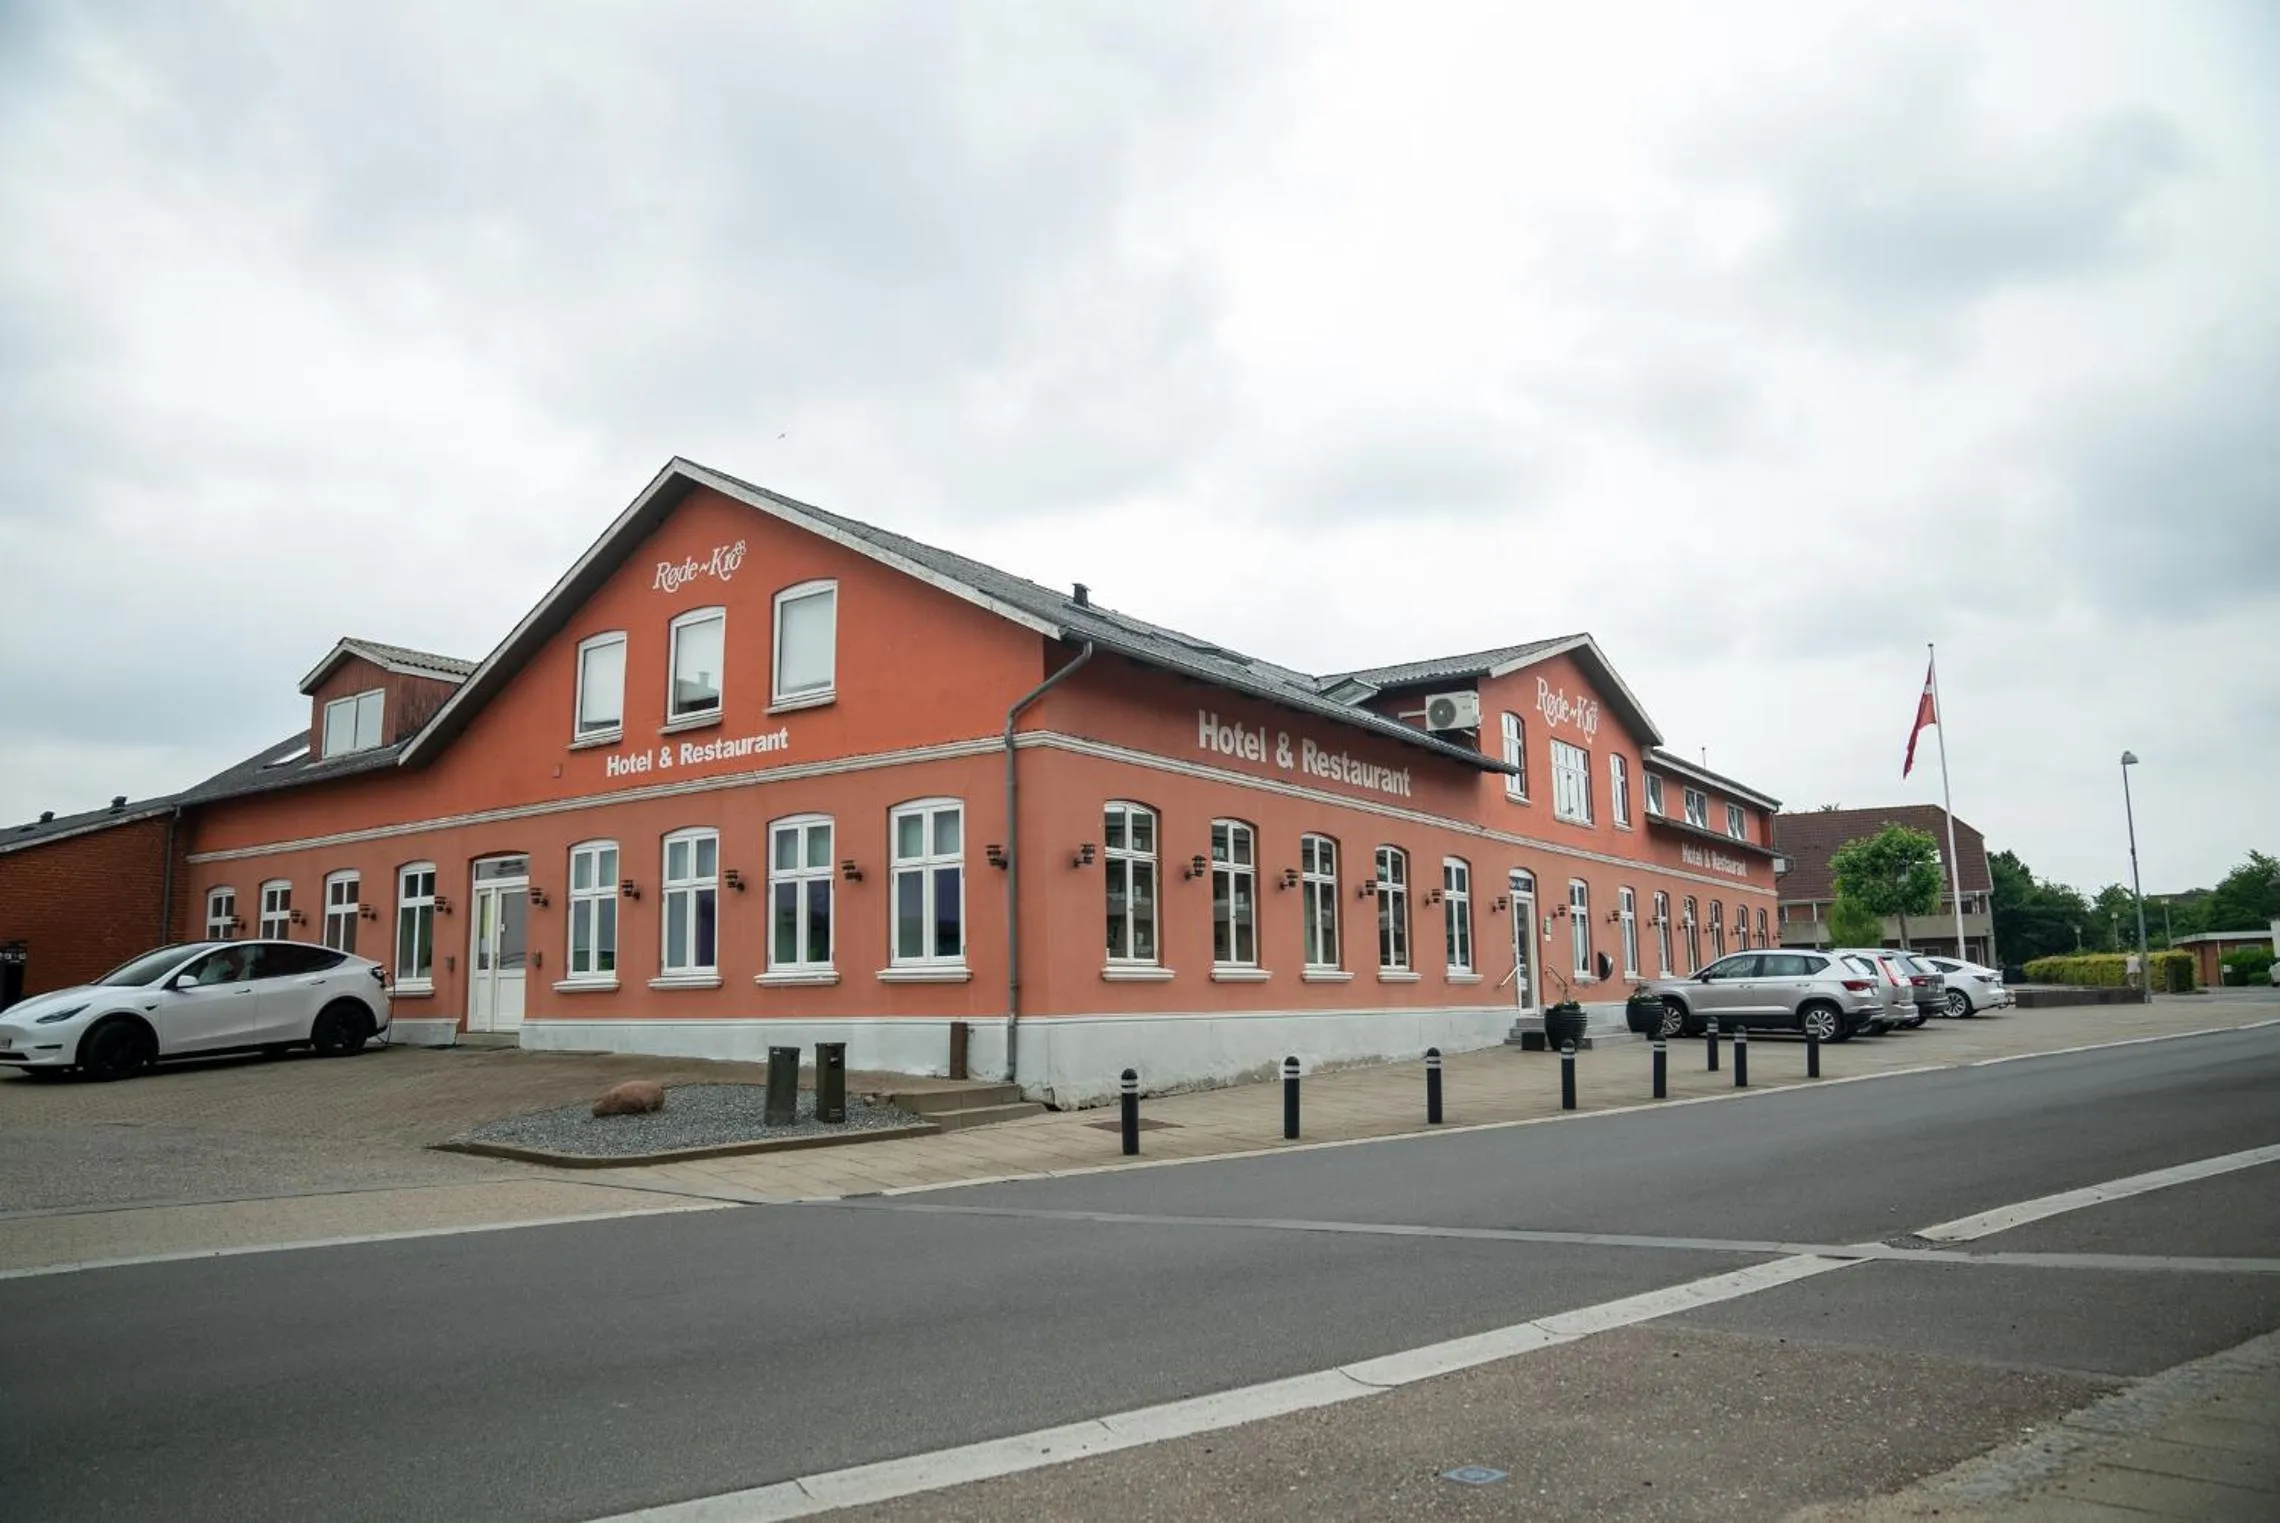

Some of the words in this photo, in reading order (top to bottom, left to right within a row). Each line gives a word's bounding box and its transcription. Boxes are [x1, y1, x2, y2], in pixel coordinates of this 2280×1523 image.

[606, 749, 653, 777] Hotel
[658, 746, 673, 768] &
[680, 727, 789, 766] Restaurant
[1198, 709, 1267, 763] Hotel
[1275, 731, 1294, 770] &
[1302, 738, 1412, 798] Restaurant
